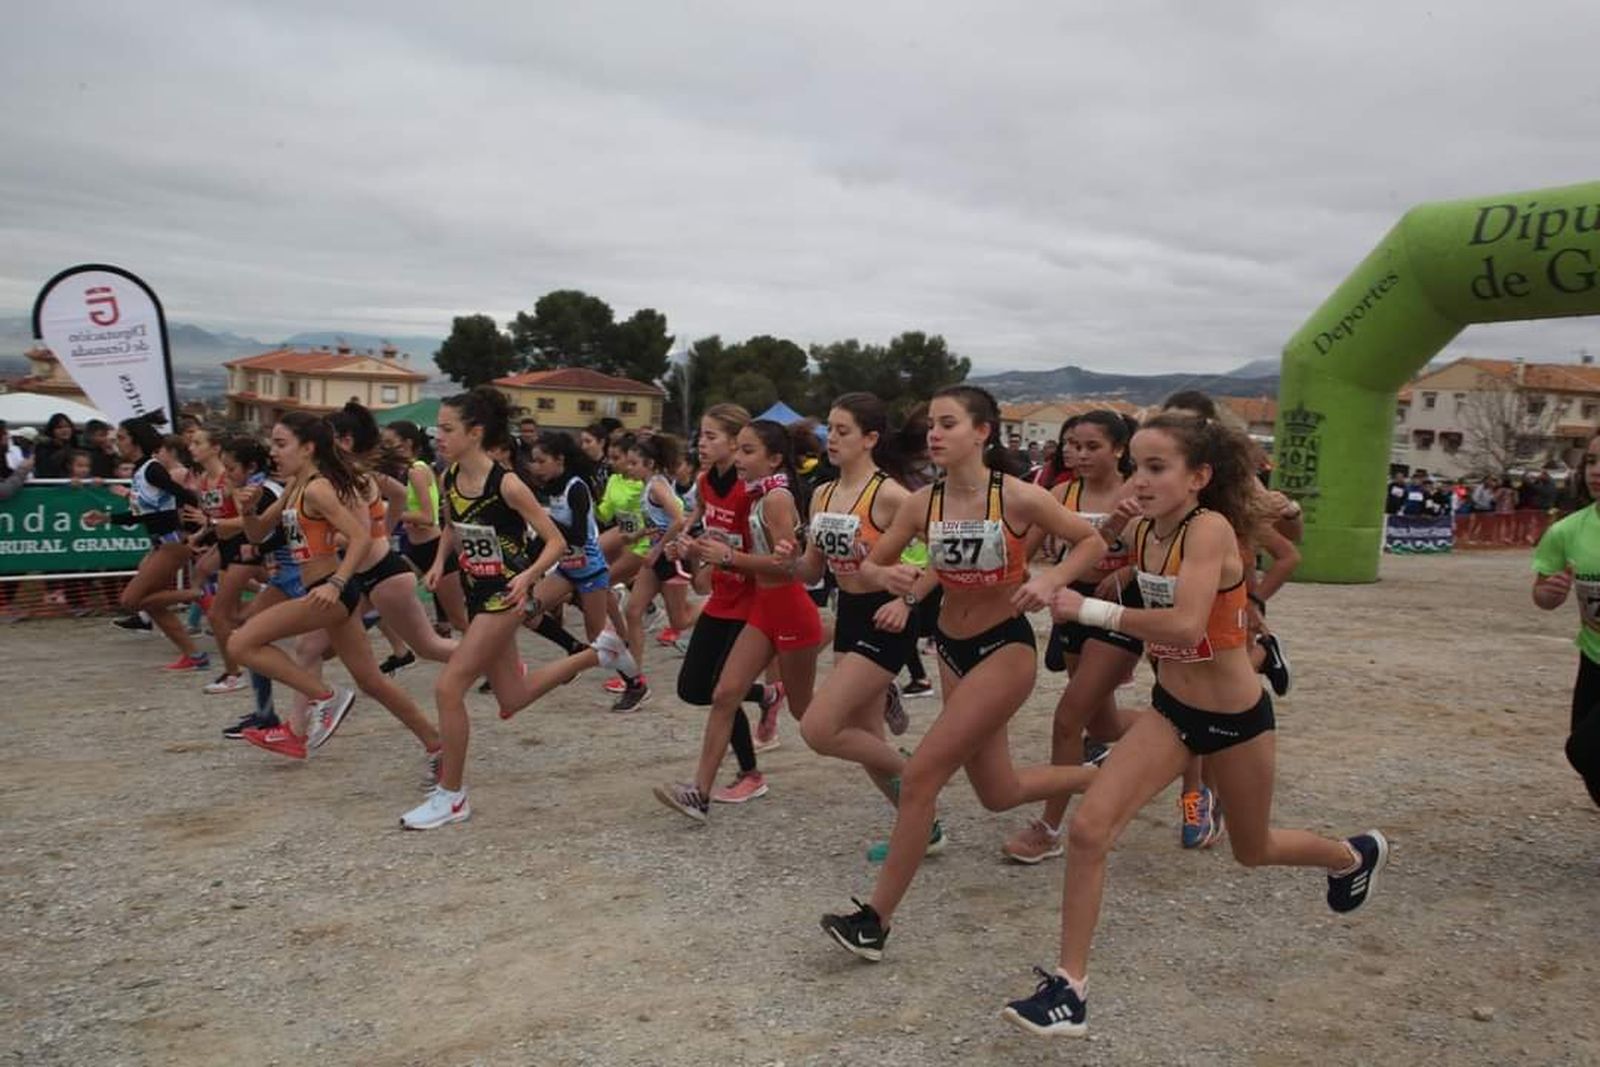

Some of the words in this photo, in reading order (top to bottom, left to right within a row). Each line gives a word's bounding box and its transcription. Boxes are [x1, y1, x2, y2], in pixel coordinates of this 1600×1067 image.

[1468, 202, 1600, 251] Dipu
[1470, 255, 1531, 300] de
[1546, 247, 1600, 294] G
[1312, 273, 1399, 355] Deportes
[0, 503, 140, 533] ndaci
[942, 538, 984, 565] 37
